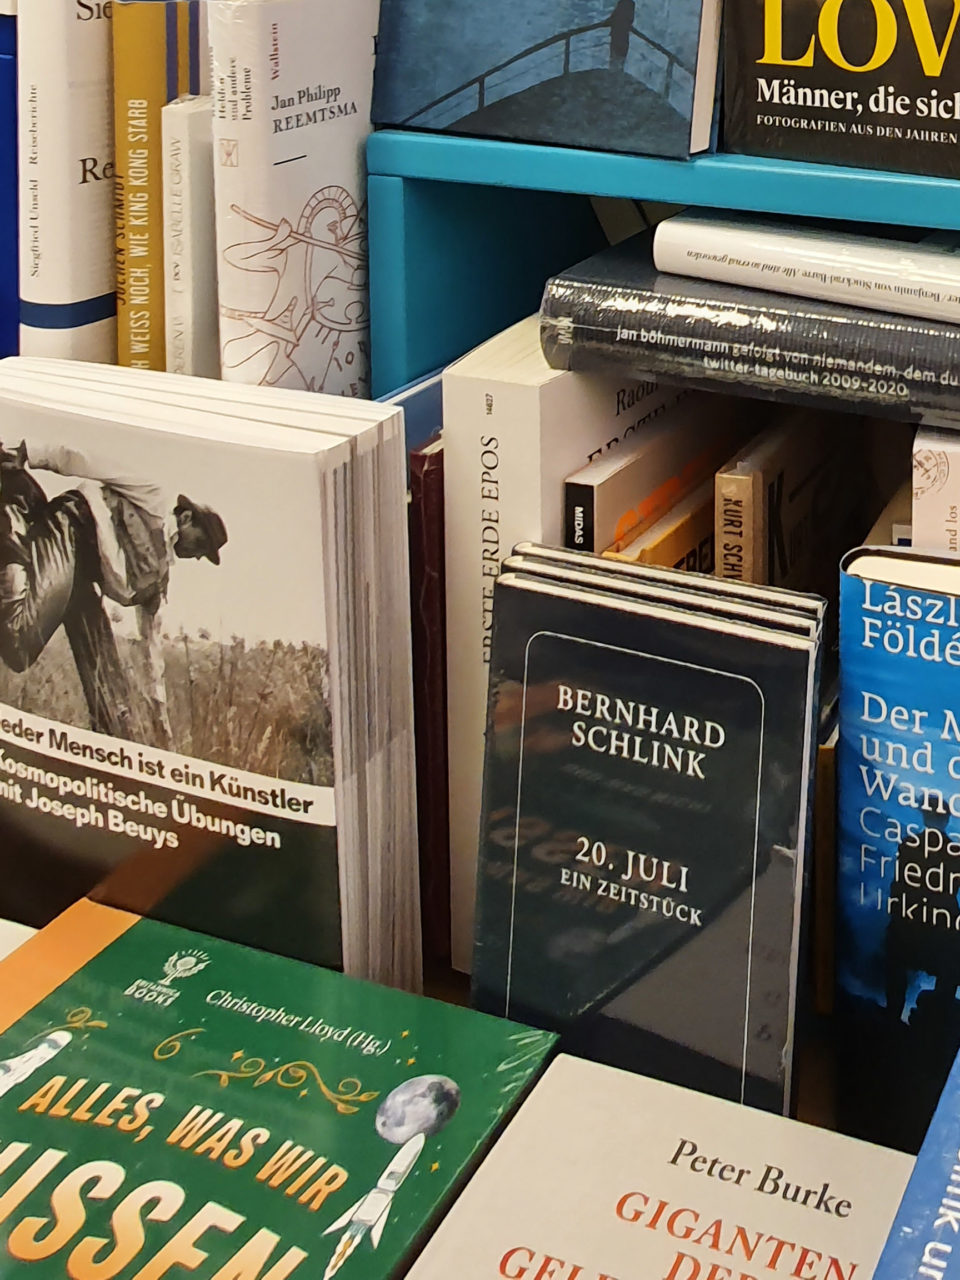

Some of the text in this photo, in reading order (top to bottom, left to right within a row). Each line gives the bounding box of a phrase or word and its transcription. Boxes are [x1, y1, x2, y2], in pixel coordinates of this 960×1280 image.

[272, 102, 359, 135] REEMTSMA
[297, 83, 342, 107] Philipp
[755, 76, 864, 117] Männer,
[868, 84, 911, 117] die
[756, 114, 847, 134] FOTOGRAFIEN
[849, 123, 874, 137] AUS
[876, 125, 903, 139] DEN
[905, 128, 959, 146] JAHREN
[127, 149, 152, 354] WEISS WIE KING KONG
[639, 328, 937, 384] böhmermann dem
[822, 371, 908, 397] 2009-2020
[480, 434, 500, 579] ERDE EPOS
[573, 505, 584, 545] MIDAS
[556, 684, 727, 749] BERNHARD
[860, 691, 929, 734] Der
[48, 728, 314, 816] Mensch ist ein Künstler
[570, 721, 707, 779] SCHLINK
[859, 734, 935, 775] und
[25, 785, 180, 850] Joseph Beuys
[170, 796, 282, 849] Übungen
[574, 835, 690, 893] 20. JULI
[559, 868, 702, 927] EIN ZEITSTÜCK
[205, 988, 392, 1057] Christopher Lloyd (Hg.)
[18, 1074, 350, 1213] ALLES, WAS WIR
[667, 1138, 853, 1219] Peter Burke
